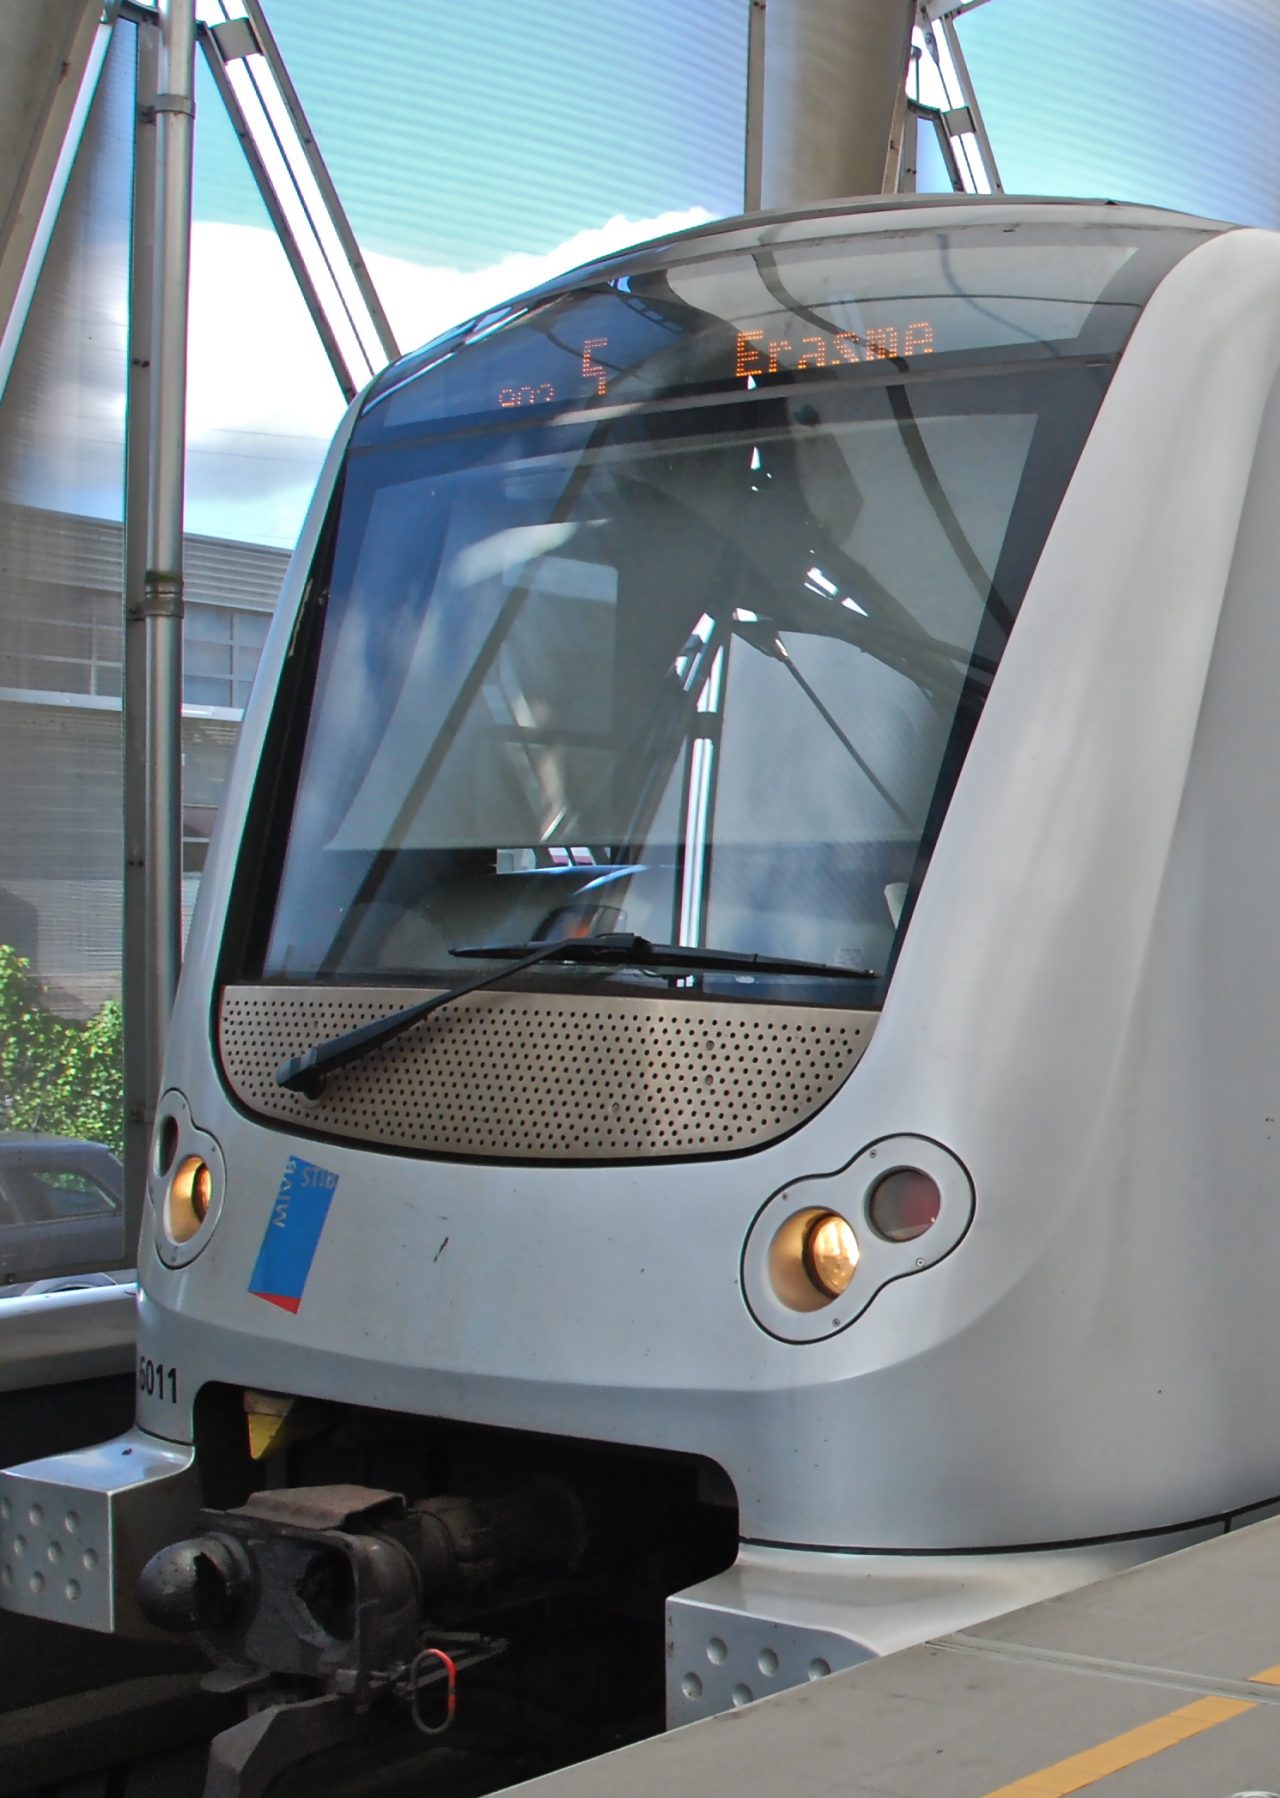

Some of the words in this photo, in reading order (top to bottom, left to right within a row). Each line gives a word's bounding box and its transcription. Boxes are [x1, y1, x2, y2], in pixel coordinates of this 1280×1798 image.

[736, 321, 934, 377] Erasme
[273, 1160, 296, 1229] MIVB
[301, 1166, 337, 1189] STIB
